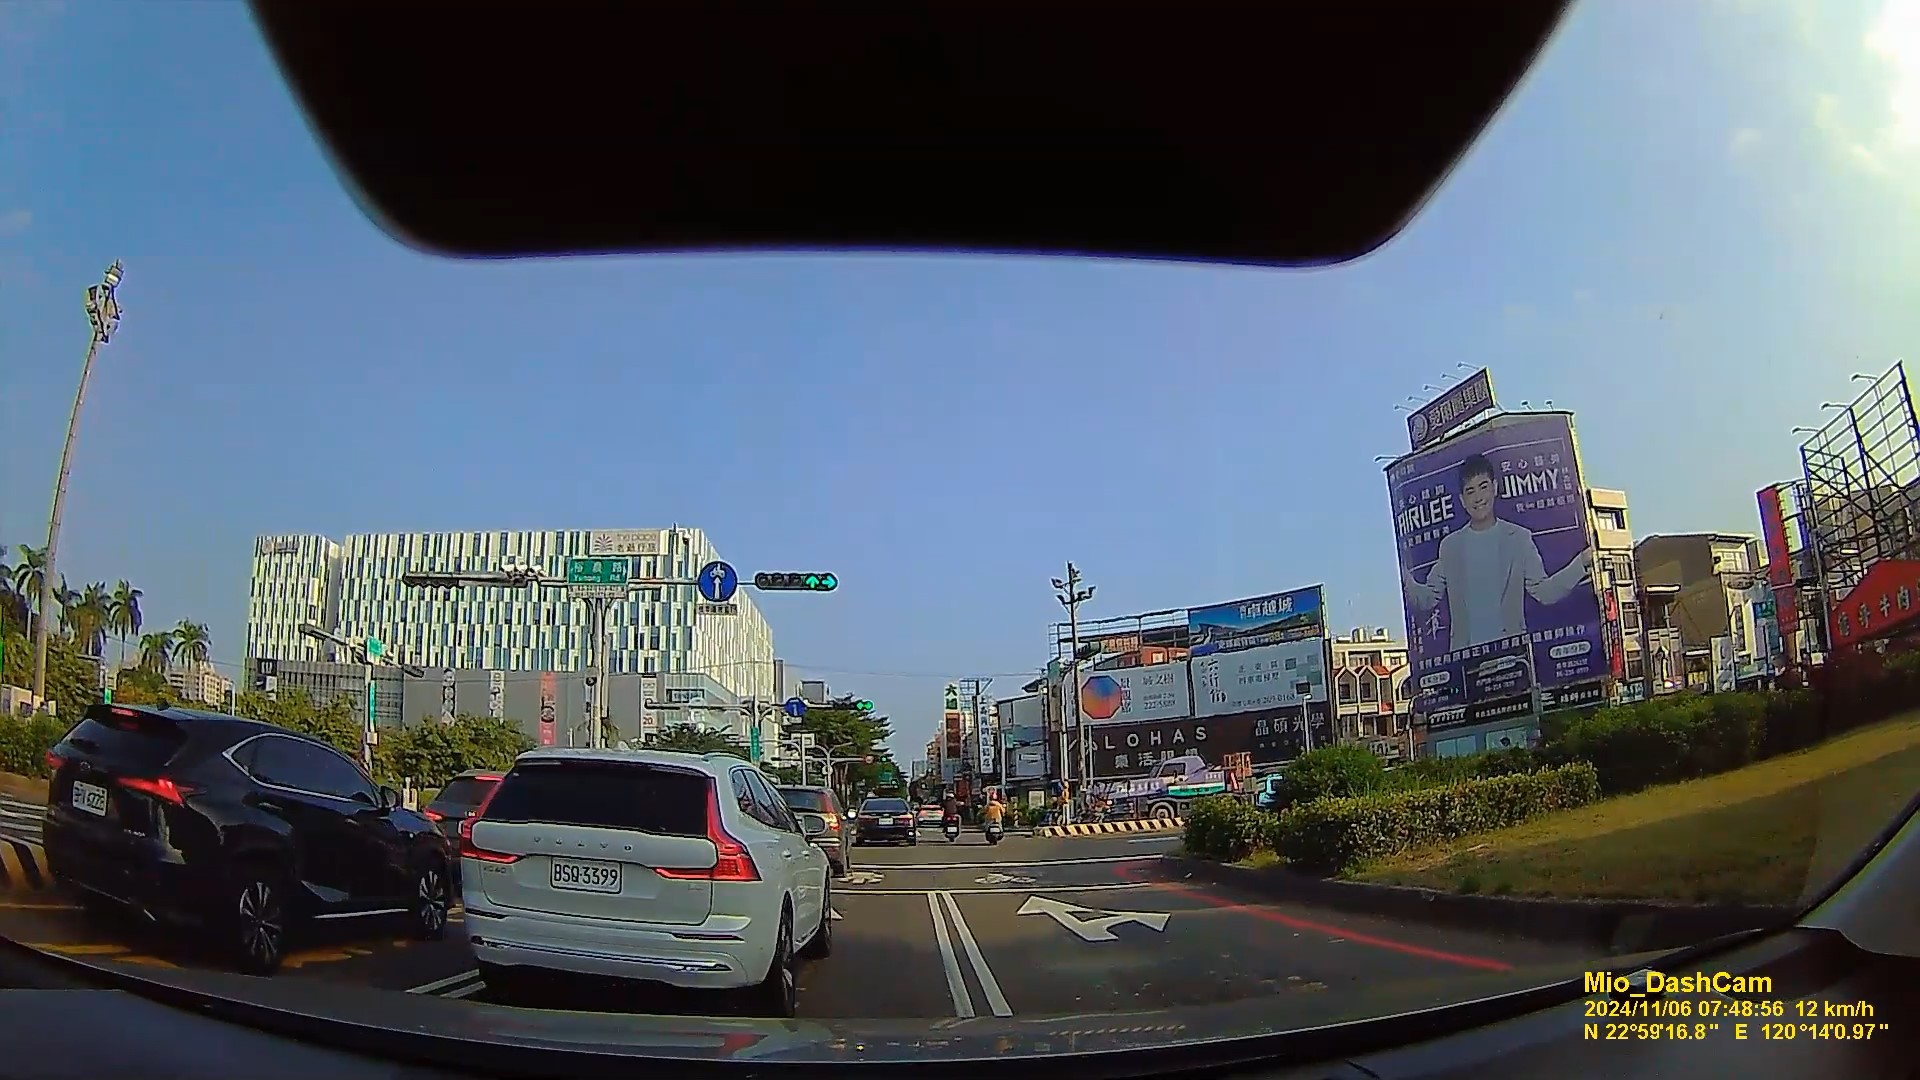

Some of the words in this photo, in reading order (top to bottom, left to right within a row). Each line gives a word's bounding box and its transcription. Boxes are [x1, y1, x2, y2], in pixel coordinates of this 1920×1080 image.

[1501, 468, 1558, 499] JIMMY
[1397, 494, 1454, 537] AIRLEE
[1105, 726, 1207, 750] LOHAS
